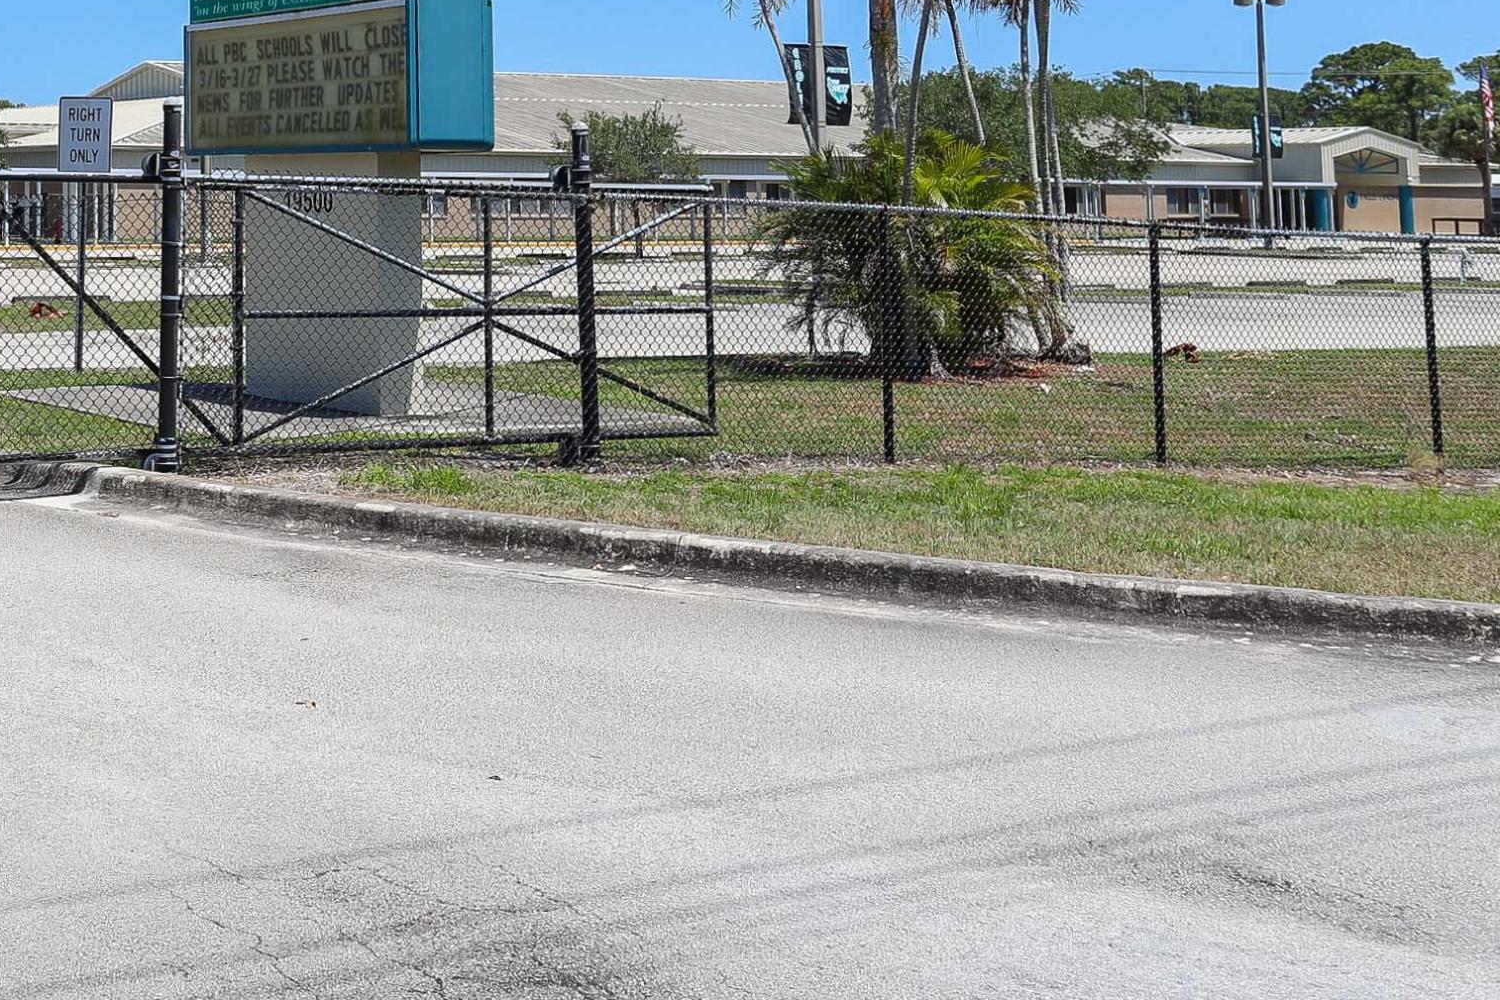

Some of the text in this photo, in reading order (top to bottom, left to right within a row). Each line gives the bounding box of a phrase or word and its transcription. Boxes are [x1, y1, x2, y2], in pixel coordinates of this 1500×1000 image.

[213, 3, 228, 14] the
[232, 0, 264, 11] wings
[197, 23, 406, 66] ALL PBC SCHOOLS WILL CLOSE
[267, 60, 315, 85] PLEASE
[322, 54, 370, 80] WATCH
[380, 52, 405, 76] THE
[197, 80, 399, 114] NEWS FOR FURTHER UPDATES
[68, 107, 102, 121] RIGHT
[198, 117, 220, 139] ALL
[228, 114, 271, 138] EVENTS
[276, 109, 350, 135] CANCELLED
[354, 107, 373, 132] AS
[70, 127, 100, 142] TURN
[69, 148, 99, 163] ONLY
